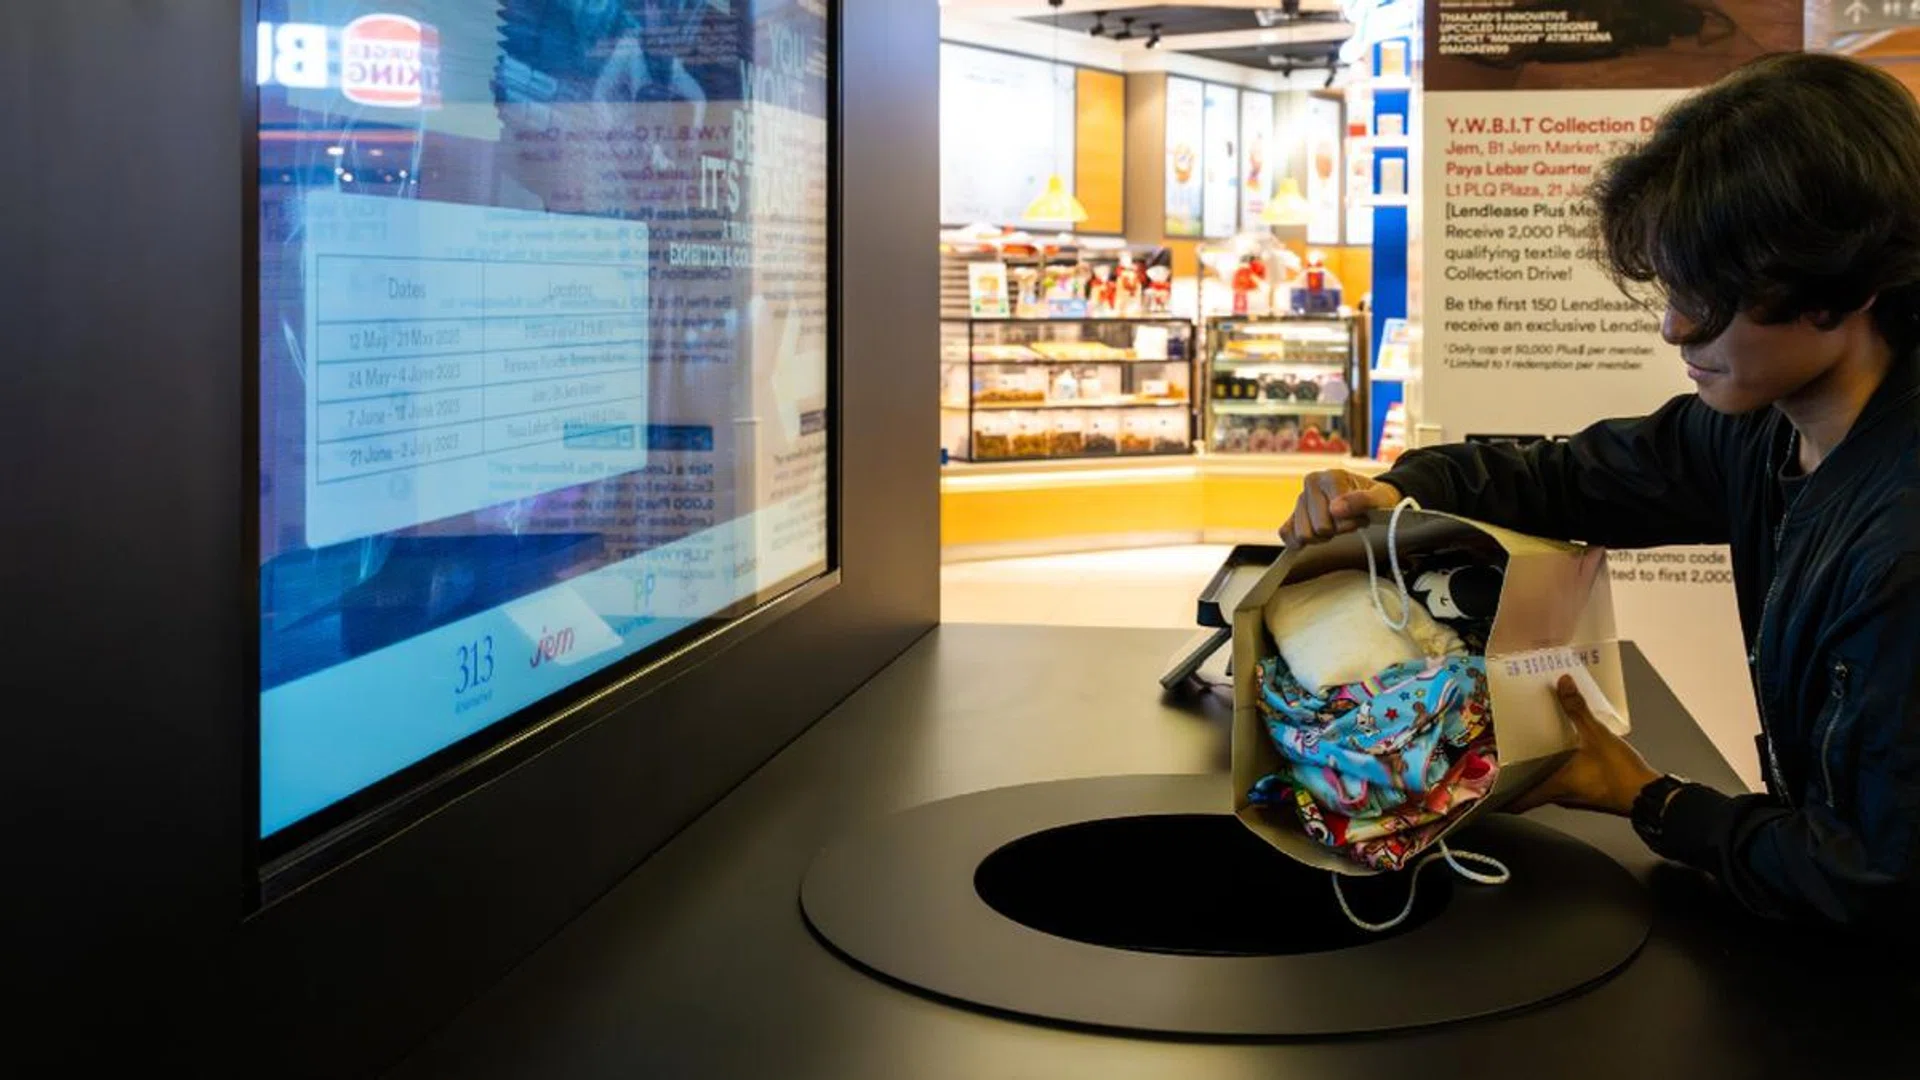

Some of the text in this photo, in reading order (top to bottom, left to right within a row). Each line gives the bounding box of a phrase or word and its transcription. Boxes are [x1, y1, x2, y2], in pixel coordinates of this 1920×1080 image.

[1440, 11, 1568, 22] THAILAND'S INNOVATIVE
[1439, 21, 1598, 33] UPCYCLED FASHION DESIGNER
[1447, 117, 1534, 134] Y.W.B.I.T
[1539, 116, 1634, 134] Collection
[1446, 141, 1484, 157] Jem,
[1488, 141, 1503, 155] B1
[1508, 141, 1541, 155] Jem
[1545, 141, 1603, 156] Market,
[1447, 161, 1592, 178] Paya Lebar Quarter
[1465, 183, 1497, 198] PLQ
[1501, 183, 1544, 199] Plaza,
[1446, 202, 1529, 219] [Lendlease
[1534, 202, 1565, 217] Plus
[1446, 225, 1504, 239] Receive
[1508, 225, 1553, 241] 2,000
[1445, 245, 1519, 263] qualifying
[1524, 245, 1571, 259] textile
[1445, 265, 1573, 281] Collection Drive!
[387, 276, 427, 301] Dates
[1446, 297, 1464, 311] Be
[1469, 297, 1493, 311] the
[1498, 297, 1526, 311] first
[1531, 297, 1556, 311] 150
[1562, 297, 1641, 311] Lendlease
[1445, 318, 1499, 333] receive
[1503, 321, 1522, 333] an
[1526, 318, 1596, 333] exclusive
[1587, 346, 1606, 357] per
[1491, 360, 1503, 370] to
[1513, 360, 1574, 372] redemption
[1576, 361, 1594, 372] per
[1637, 551, 1685, 564] promo
[1688, 550, 1726, 564] code
[1611, 568, 1636, 582] ted
[1640, 569, 1655, 582] to
[1658, 568, 1687, 582] first
[529, 626, 574, 668] jem
[455, 635, 494, 694] 313
